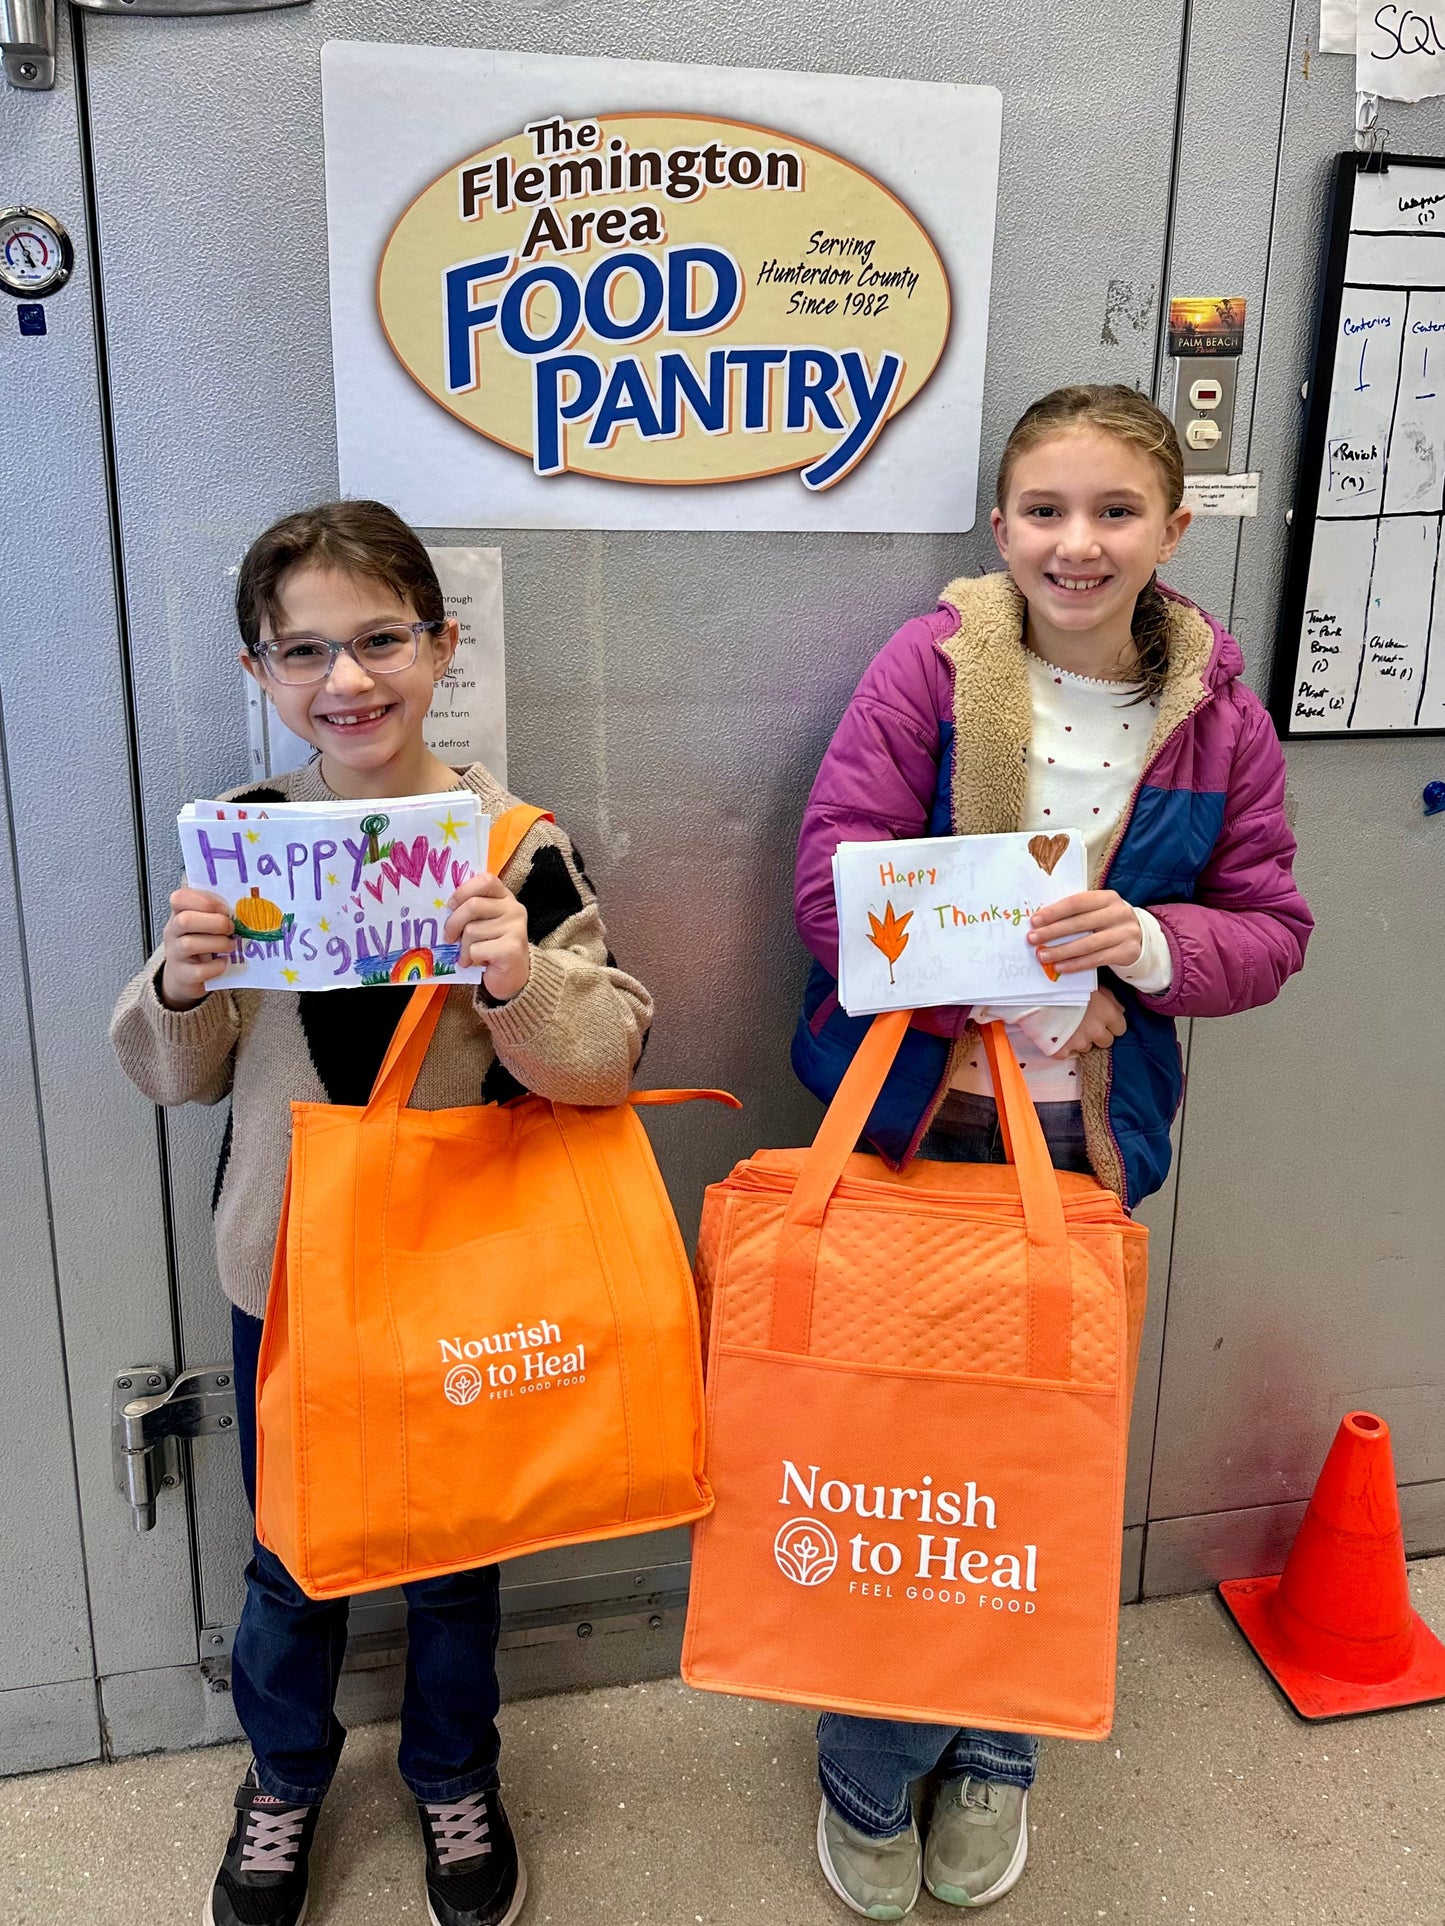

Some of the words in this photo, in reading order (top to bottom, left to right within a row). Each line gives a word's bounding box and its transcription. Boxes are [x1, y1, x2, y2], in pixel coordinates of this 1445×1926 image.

[528, 120, 596, 155] The
[462, 139, 799, 217] Flemington
[522, 206, 661, 258] Area
[806, 231, 876, 265] Serving
[757, 259, 854, 286] Hunterdon
[857, 262, 920, 299] County
[446, 247, 738, 390] FOOD
[786, 291, 839, 315] Since
[843, 292, 890, 317] 1982
[1178, 337, 1203, 347] PALM
[1206, 337, 1238, 347] BEACH
[536, 350, 900, 486] PANTRY
[442, 595, 473, 606] hrough
[457, 636, 477, 646] ycle
[460, 622, 472, 631] be
[447, 666, 464, 675] hen
[1312, 658, 1329, 674] (1)
[441, 679, 459, 688] fans
[430, 710, 449, 718] fans
[451, 710, 470, 718] turn
[438, 738, 470, 748] defrost
[196, 828, 370, 901] Happy
[879, 861, 938, 889] Happy
[933, 901, 1043, 929] Thanksgiv
[437, 1319, 562, 1363] Nourish
[486, 1362, 517, 1387] to
[522, 1343, 586, 1381] Heal
[489, 1390, 514, 1400] FEEL
[520, 1382, 551, 1394] GOOD
[556, 1374, 586, 1387] FOOD
[778, 1459, 998, 1530] Nourish
[849, 1532, 902, 1576] to
[914, 1533, 1038, 1593] Heal
[849, 1581, 893, 1598] FEEL
[906, 1586, 967, 1606] GOOD
[979, 1595, 1036, 1615] FOOD
